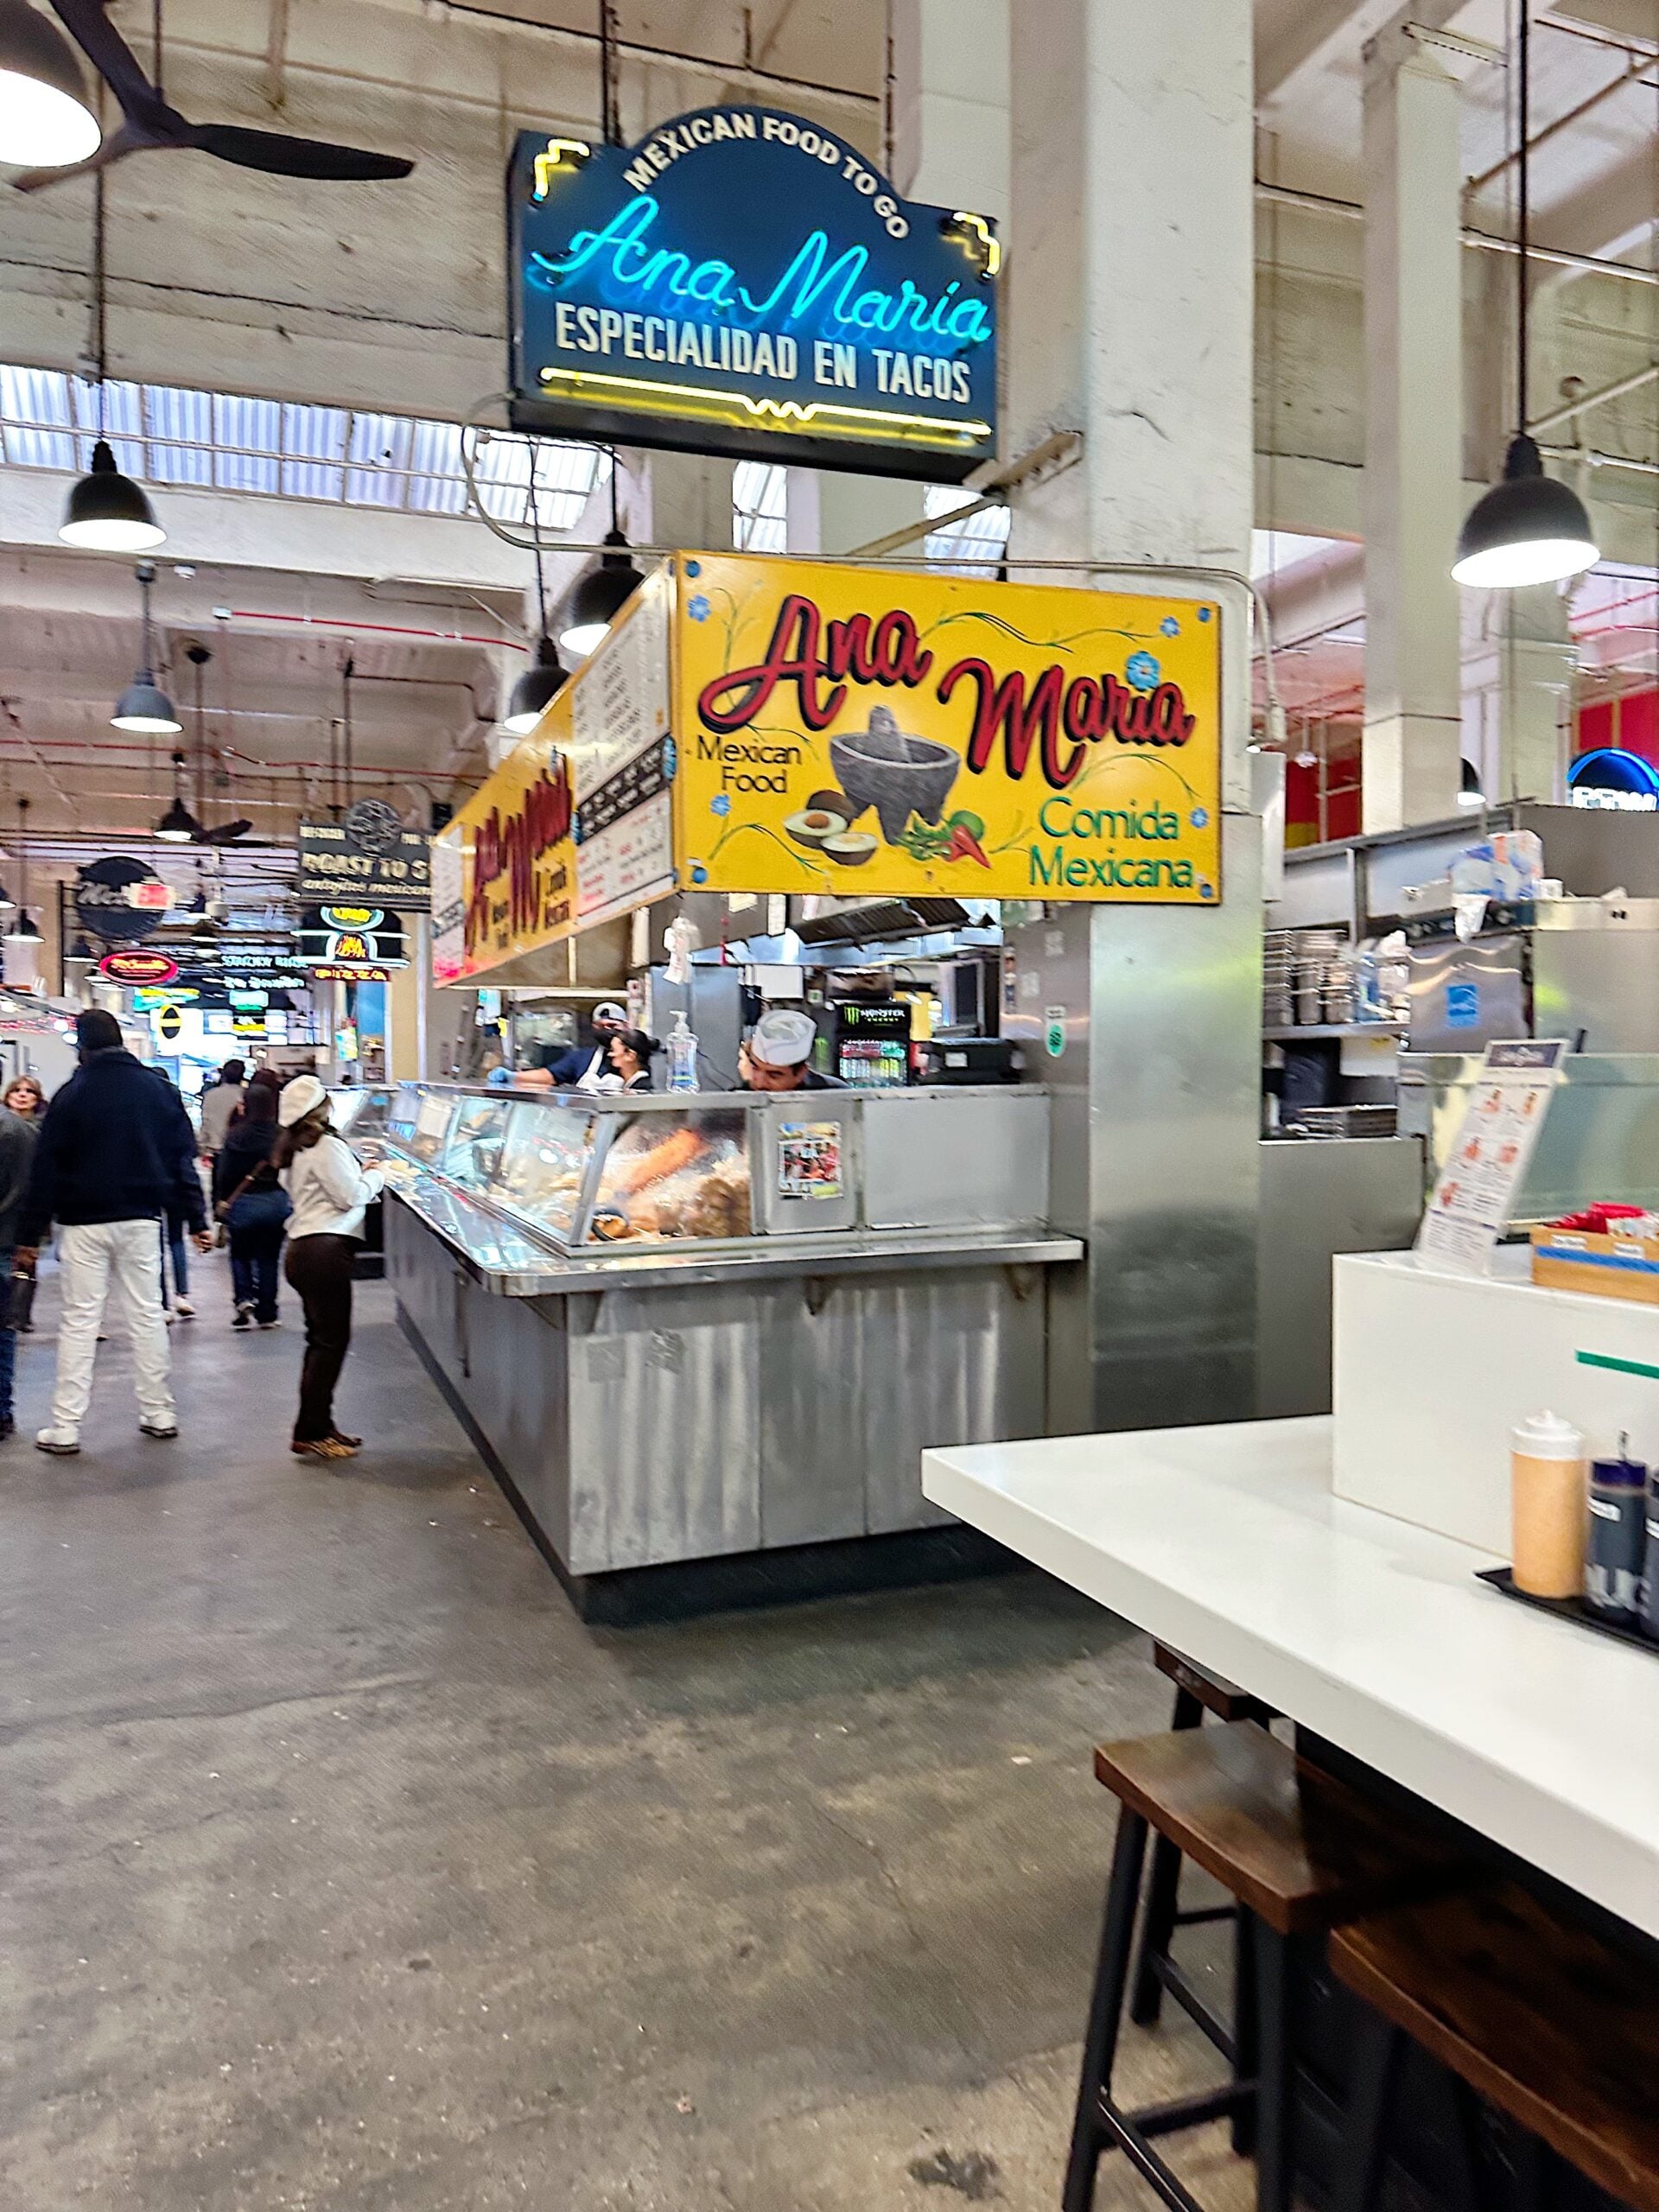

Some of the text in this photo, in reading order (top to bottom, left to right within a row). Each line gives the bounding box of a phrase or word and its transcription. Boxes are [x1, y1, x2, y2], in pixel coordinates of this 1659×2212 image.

[623, 113, 910, 240] MEXICAN FOOD TO GO
[531, 194, 736, 308] Ana
[556, 302, 972, 404] ESPECIALIDAD EN TACOS
[698, 594, 934, 734] Ana
[697, 734, 802, 766] Mexican
[722, 766, 788, 794] Food
[1039, 797, 1179, 842] Comida
[1029, 845, 1193, 889] Mexicana
[315, 969, 387, 981] PIZZA
[861, 1008, 906, 1017] MONSTER
